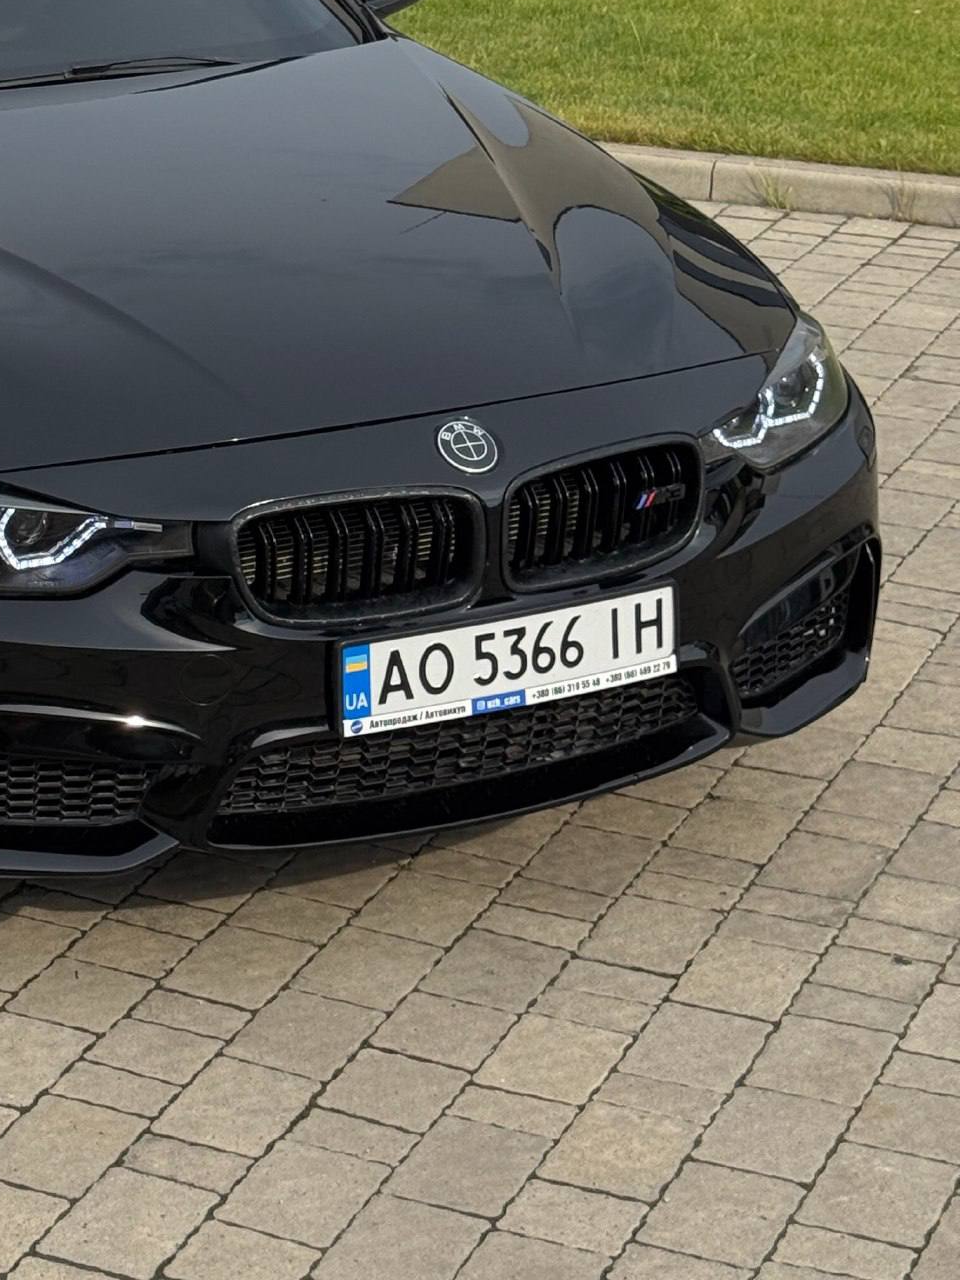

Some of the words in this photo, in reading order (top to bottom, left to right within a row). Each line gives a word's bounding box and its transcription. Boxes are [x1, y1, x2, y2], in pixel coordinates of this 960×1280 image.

[442, 423, 484, 441] BMW
[378, 642, 456, 705] AO
[473, 614, 585, 687] 5366
[611, 597, 664, 660] IH
[345, 692, 369, 711] UA
[369, 715, 418, 730] Автопродаж
